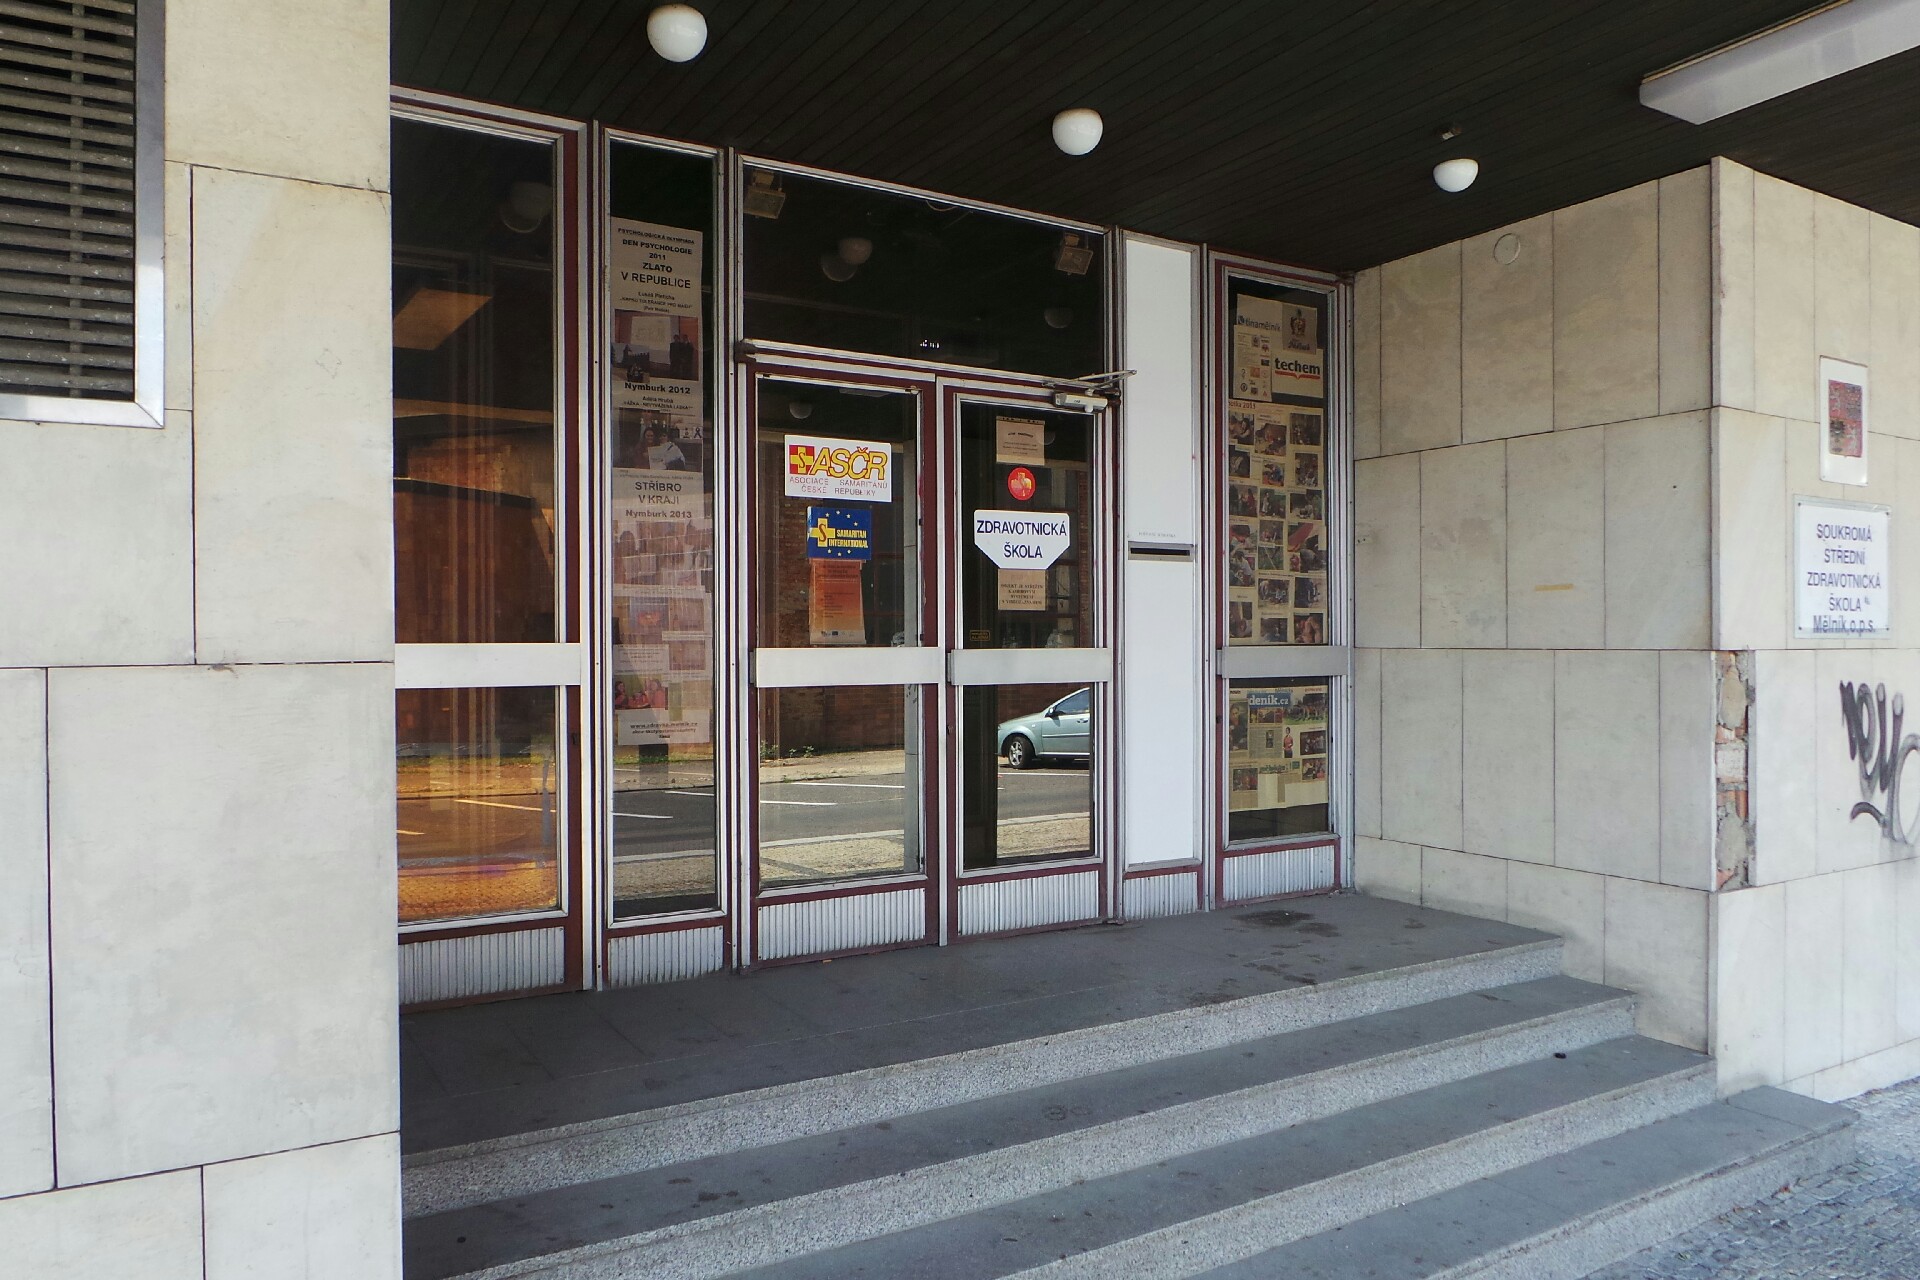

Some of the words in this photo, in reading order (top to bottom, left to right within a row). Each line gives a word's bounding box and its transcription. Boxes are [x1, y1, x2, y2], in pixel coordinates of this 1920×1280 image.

[622, 239, 638, 247] DEN
[640, 241, 692, 254] PSYCHOLOGIE
[649, 252, 666, 261] 2011
[642, 262, 673, 273] ZLATO
[621, 272, 629, 281] V
[631, 273, 691, 289] REPUBLICE
[1274, 357, 1321, 375] techem
[624, 382, 666, 393] Nymburk
[669, 385, 691, 395] 2012
[809, 446, 888, 480] ASČR
[635, 480, 682, 492] STŘÍBRO
[789, 476, 829, 486] ASOCIACE
[638, 495, 645, 503] V
[648, 495, 680, 505] KRAJI
[625, 509, 667, 519] Nymburk
[669, 510, 692, 519] 2013
[836, 529, 867, 539] SAMARITAN
[976, 520, 1067, 536] ZDRAVOTNICKÁ
[1816, 523, 1873, 542] SOUKROMÁ
[829, 539, 868, 549] INTERNATIONAL
[1003, 541, 1043, 559] ŠKOLA
[1824, 545, 1866, 565] STŘEDNÍ
[1807, 571, 1882, 589] ZDRAVOTNICKÁ
[1828, 593, 1862, 612] ŠKOLA
[1248, 693, 1289, 707] deník.cz
